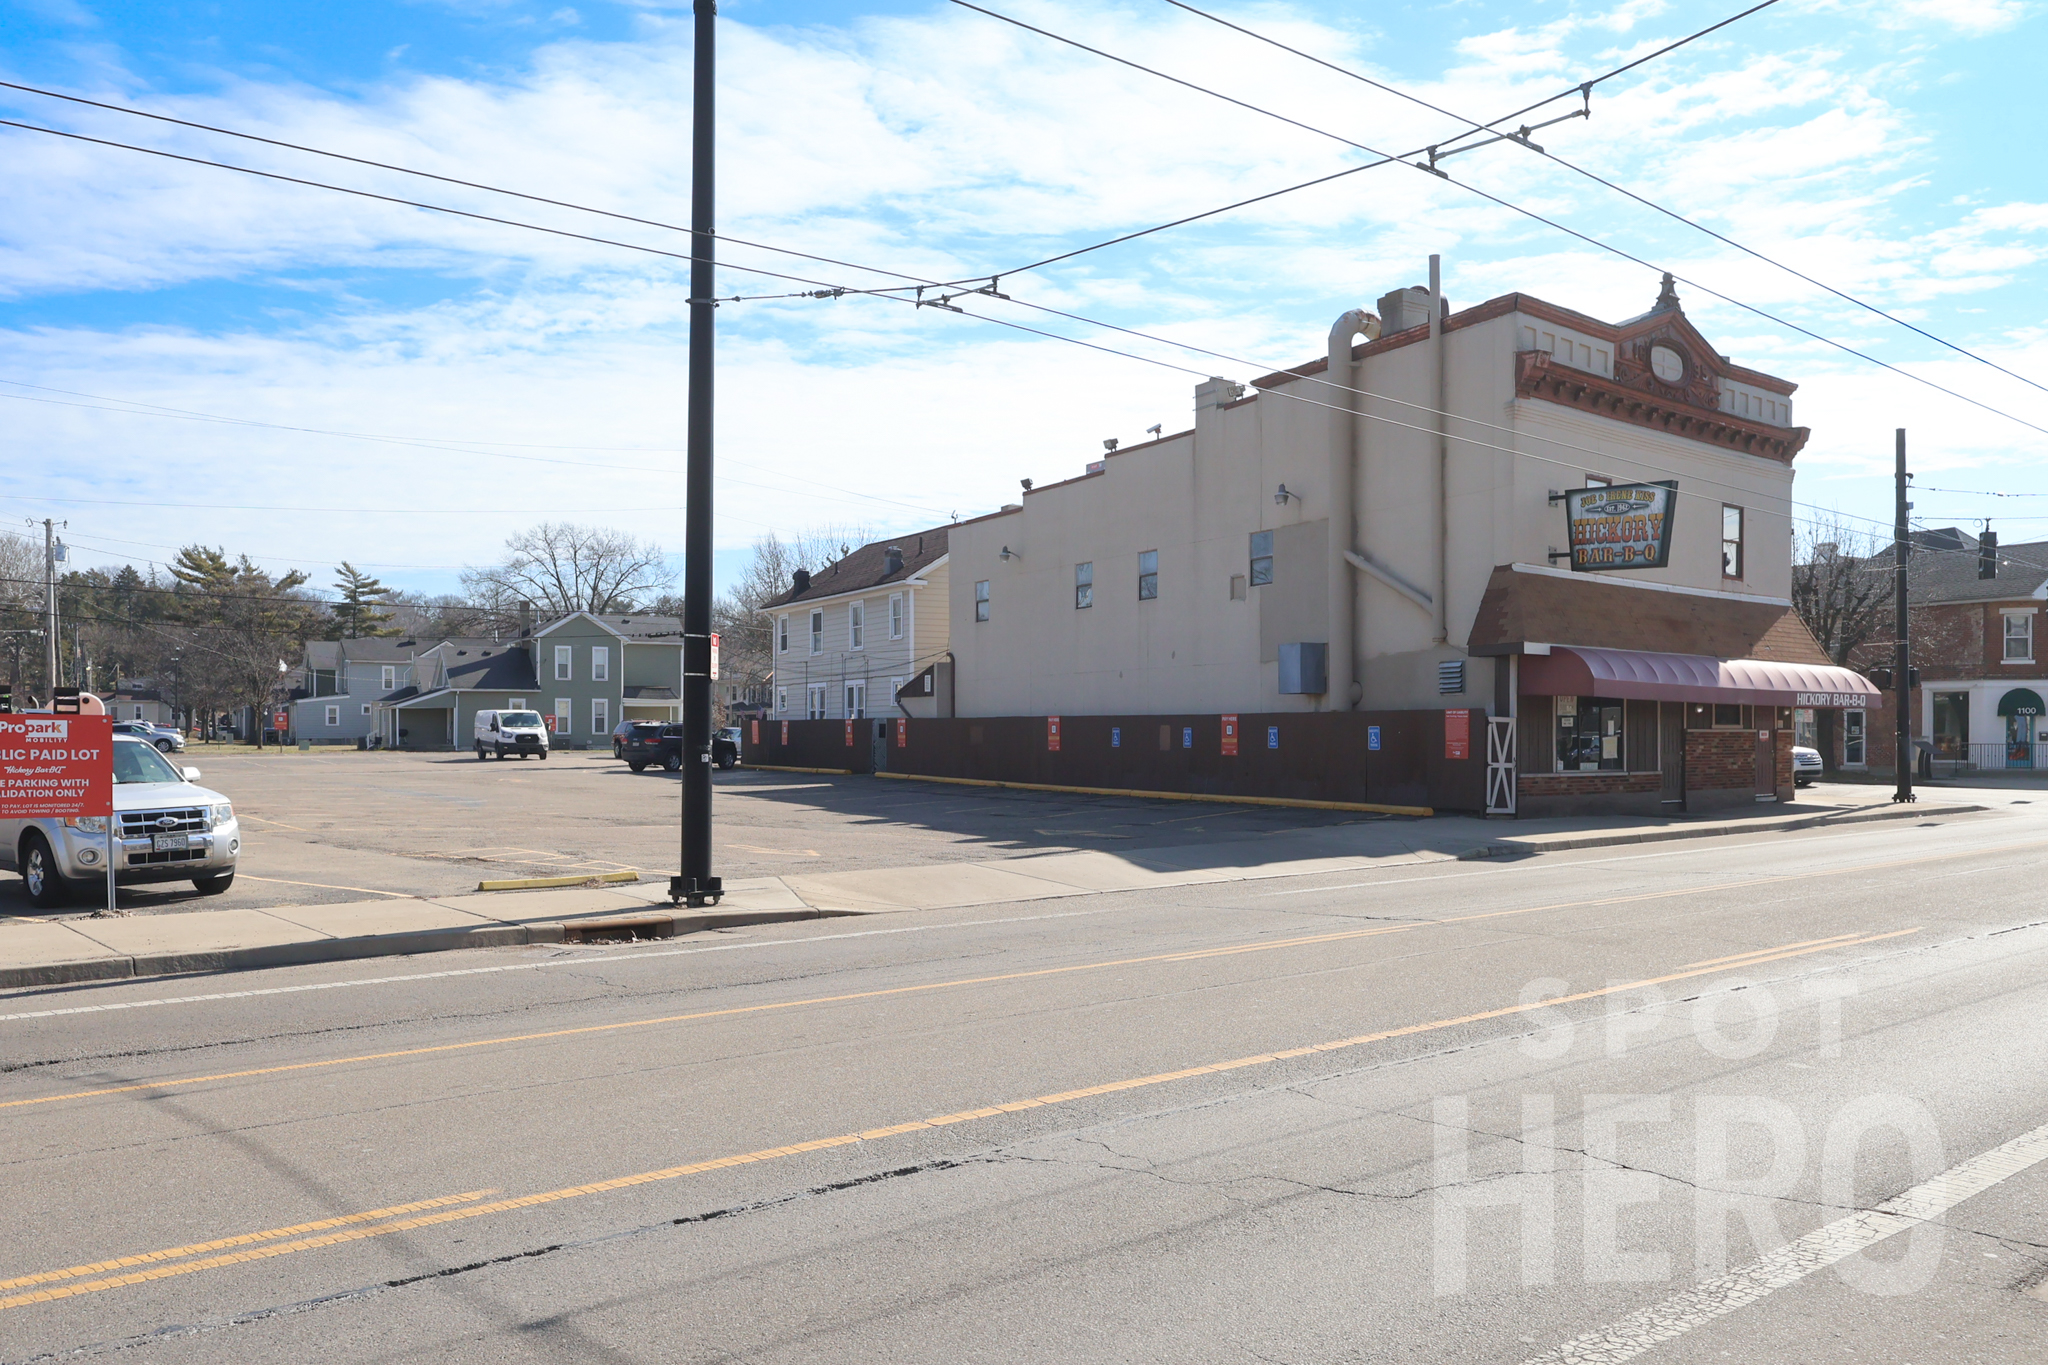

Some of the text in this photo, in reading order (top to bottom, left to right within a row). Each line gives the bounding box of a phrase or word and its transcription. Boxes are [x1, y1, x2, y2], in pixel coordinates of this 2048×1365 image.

[1581, 494, 1597, 508] JOE
[1606, 490, 1633, 502] IRENE
[1634, 490, 1656, 502] KISS
[1573, 513, 1664, 545] HICKORY
[1577, 545, 1656, 564] BAR-B-Q
[1796, 693, 1831, 706] HICKORY
[2017, 707, 2037, 715] 1100
[0, 721, 62, 736] Propark
[30, 749, 68, 760] PAID
[71, 749, 100, 760] LOT
[4, 765, 35, 776] Hickory
[8, 779, 59, 788] PARKING
[60, 779, 90, 787] WITH
[0, 789, 85, 798] LIDATION ONLY
